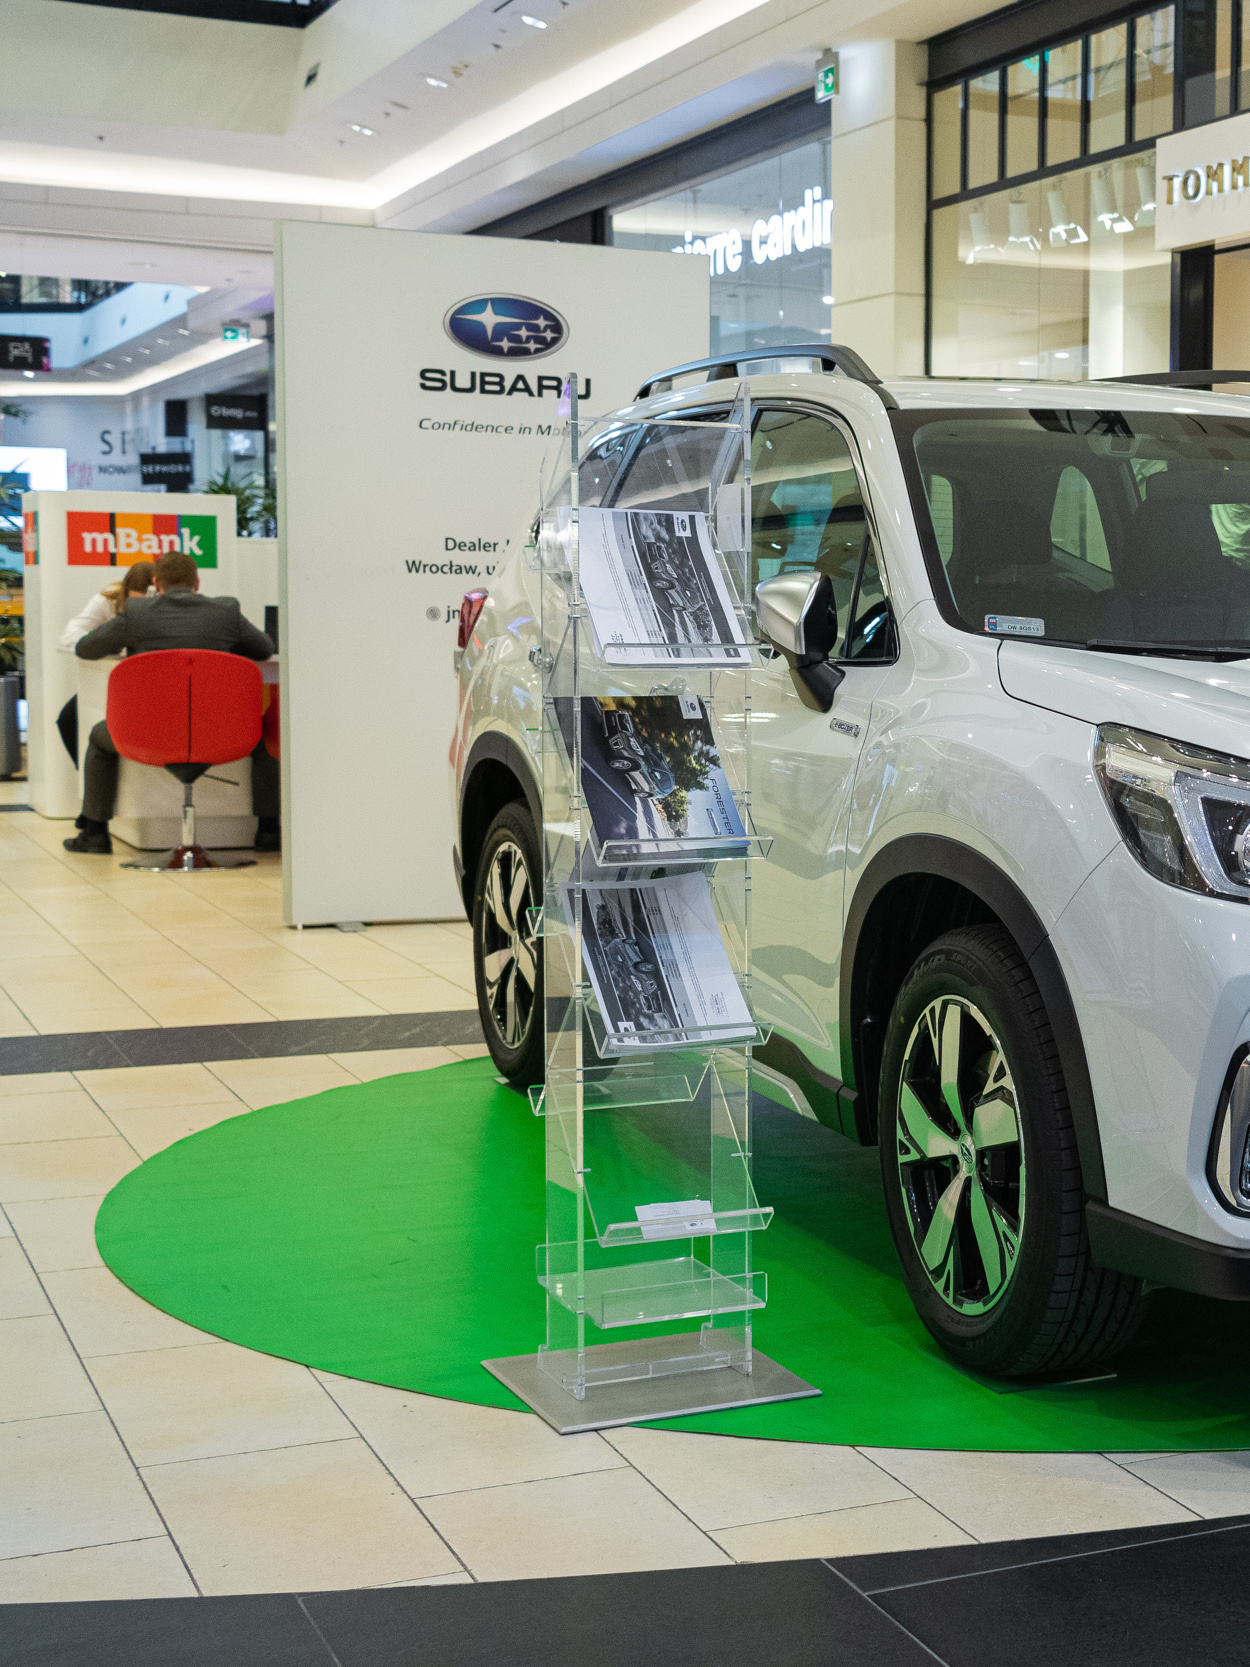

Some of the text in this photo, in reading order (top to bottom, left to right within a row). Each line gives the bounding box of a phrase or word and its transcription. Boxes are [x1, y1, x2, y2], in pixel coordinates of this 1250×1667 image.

[419, 368, 592, 400] SUBARU
[419, 417, 514, 434] Confidence
[519, 423, 532, 435] in
[82, 527, 203, 557] mBank
[445, 537, 499, 553] Dealer
[405, 559, 481, 577] Wrocław,
[710, 778, 735, 835] FORESTER
